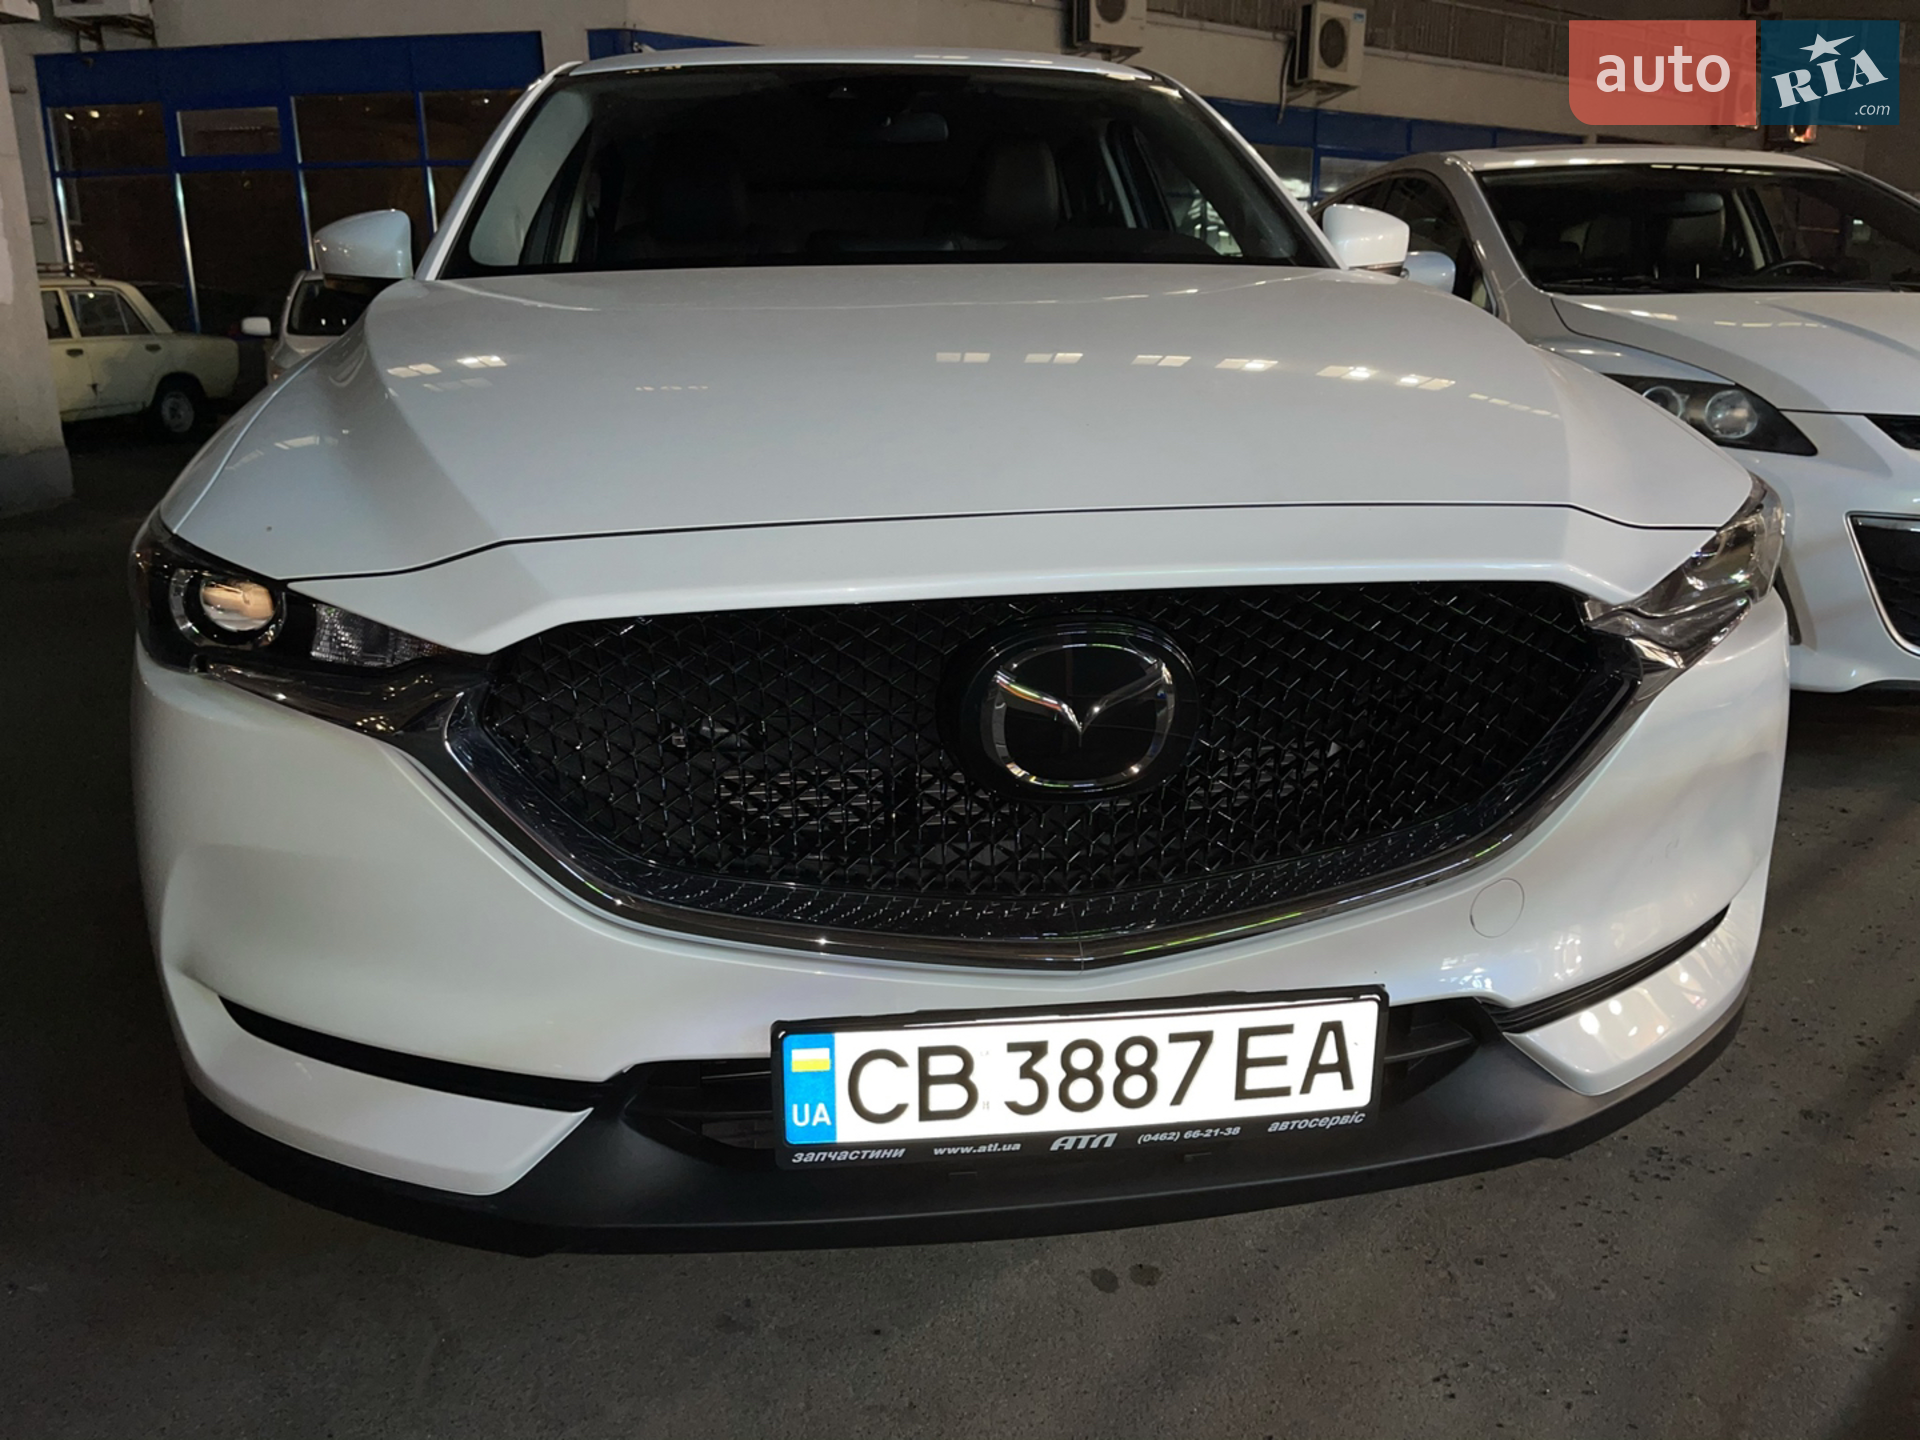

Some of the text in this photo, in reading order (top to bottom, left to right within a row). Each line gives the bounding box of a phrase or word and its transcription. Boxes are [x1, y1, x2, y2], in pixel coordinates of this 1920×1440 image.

[1004, 1031, 1214, 1115] 3887
[1235, 1020, 1354, 1100] EA
[792, 1104, 832, 1126] UA
[1267, 1111, 1366, 1133] автосервіс
[1137, 1126, 1241, 1145] (0462) 66-21-38
[791, 1147, 906, 1164] запчастини
